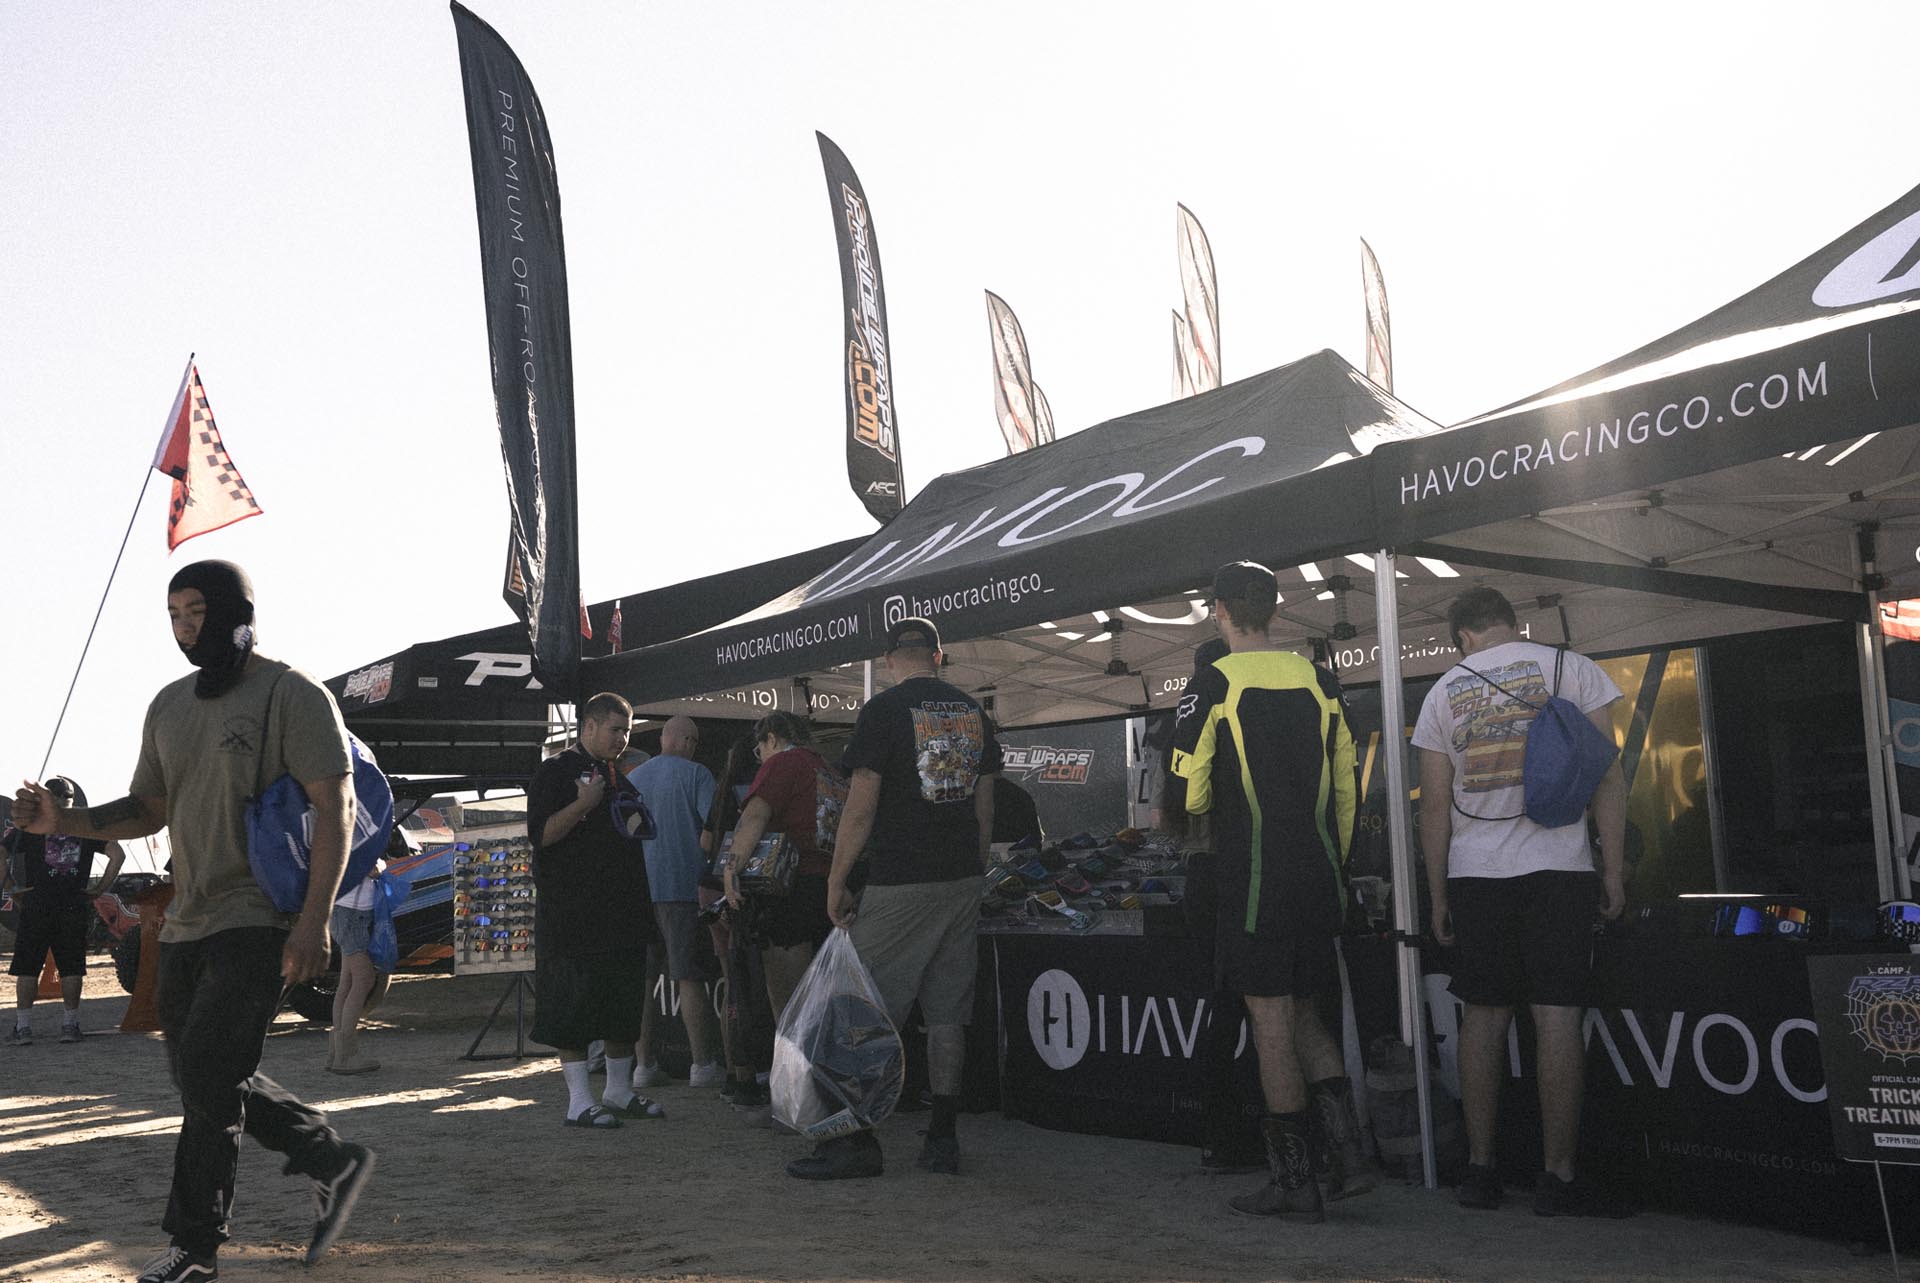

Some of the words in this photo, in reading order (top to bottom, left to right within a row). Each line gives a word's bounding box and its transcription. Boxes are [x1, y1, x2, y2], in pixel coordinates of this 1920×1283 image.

[498, 89, 524, 243] PREMIUM
[511, 256, 538, 390] OFF-RO
[1399, 360, 1830, 506] HAVOCRACINGCO.COM
[912, 571, 1055, 621] havocracingco_
[715, 614, 860, 665] HAVOCRACINGCO.COM
[921, 701, 970, 713] GLAMIS
[1030, 748, 1091, 766] WRAPS
[1042, 765, 1087, 783] .COM
[1877, 966, 1905, 975] CAMP
[1097, 993, 1247, 1060] HAV
[1872, 1075, 1905, 1084] OFFICIAL
[1868, 1087, 1920, 1105] TRICK
[1843, 1106, 1920, 1126] TREATIN
